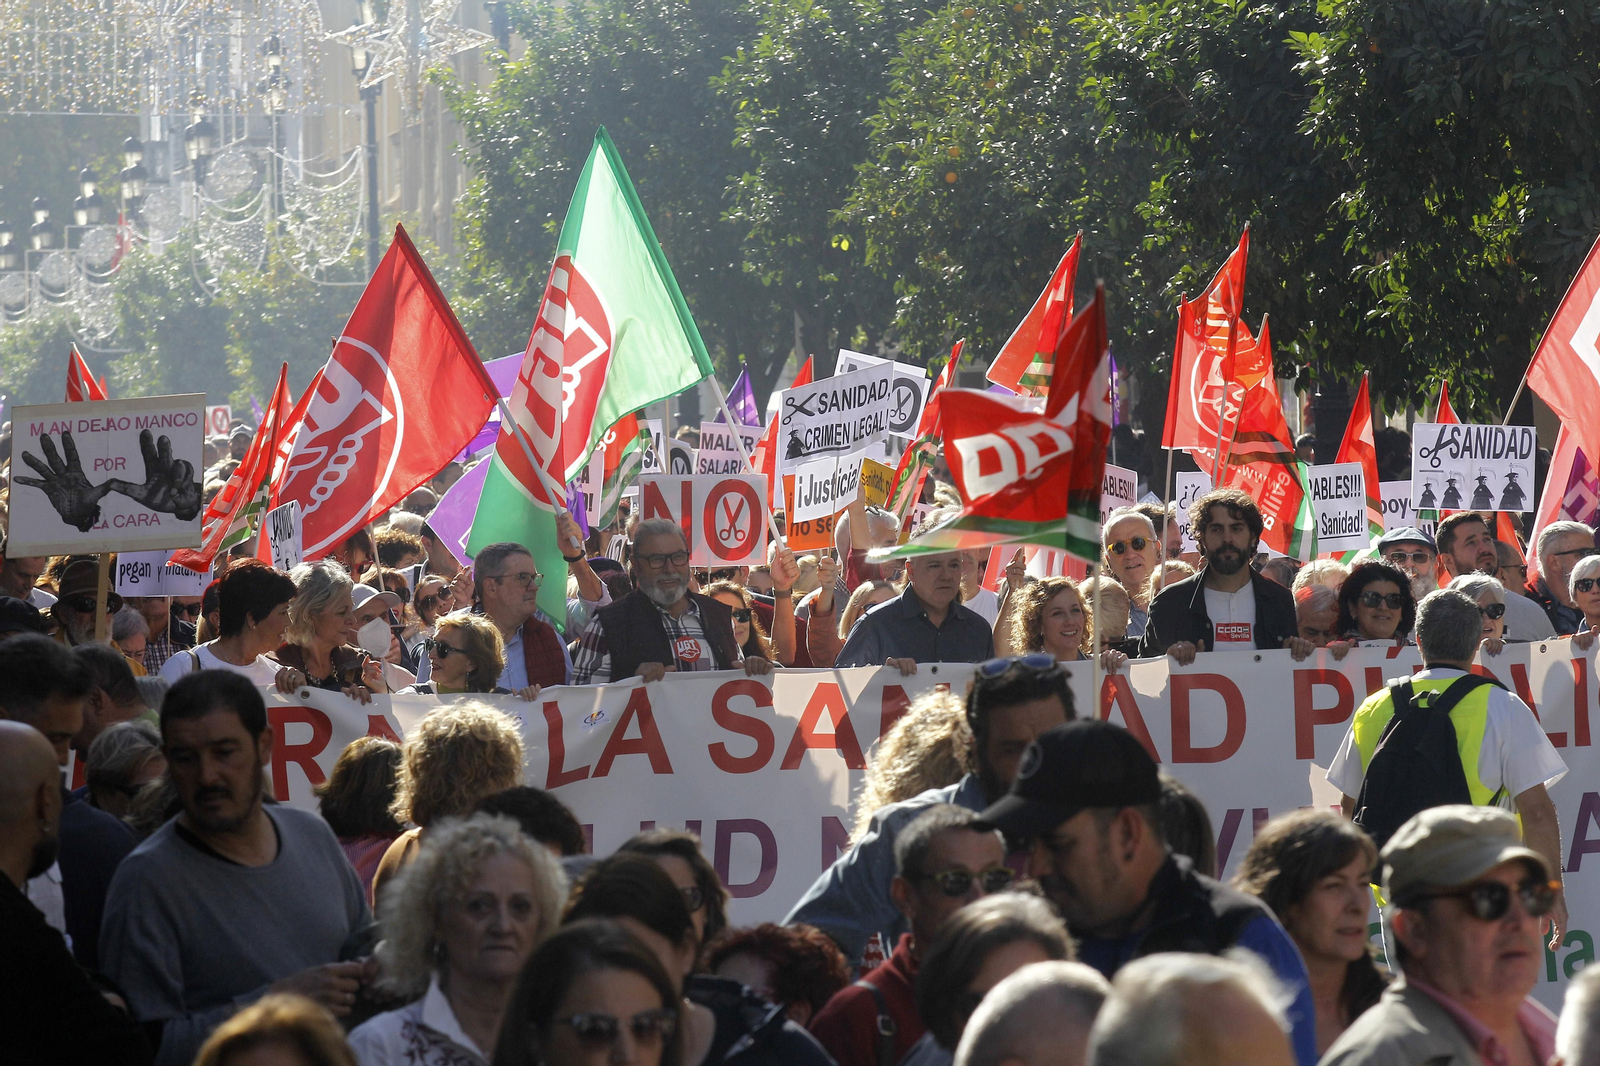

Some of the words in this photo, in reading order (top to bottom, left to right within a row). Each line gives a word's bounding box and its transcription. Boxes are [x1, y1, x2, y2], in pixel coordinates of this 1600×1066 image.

[818, 378, 891, 414] SANIDAD,
[135, 412, 198, 430] MANCO
[804, 421, 851, 451] CRIMEN
[853, 408, 889, 441] LEGAL!
[1449, 426, 1533, 460] SANIDAD
[94, 457, 126, 471] POR
[699, 458, 742, 475] SALARI
[1102, 474, 1135, 501] ABLES!!!
[92, 517, 109, 530] LA
[113, 513, 161, 528] CARA
[643, 479, 763, 561] NO
[1321, 509, 1364, 536] Sanidad!
[120, 561, 151, 586] pegan
[676, 639, 698, 652] UGT
[542, 686, 675, 790] LA
